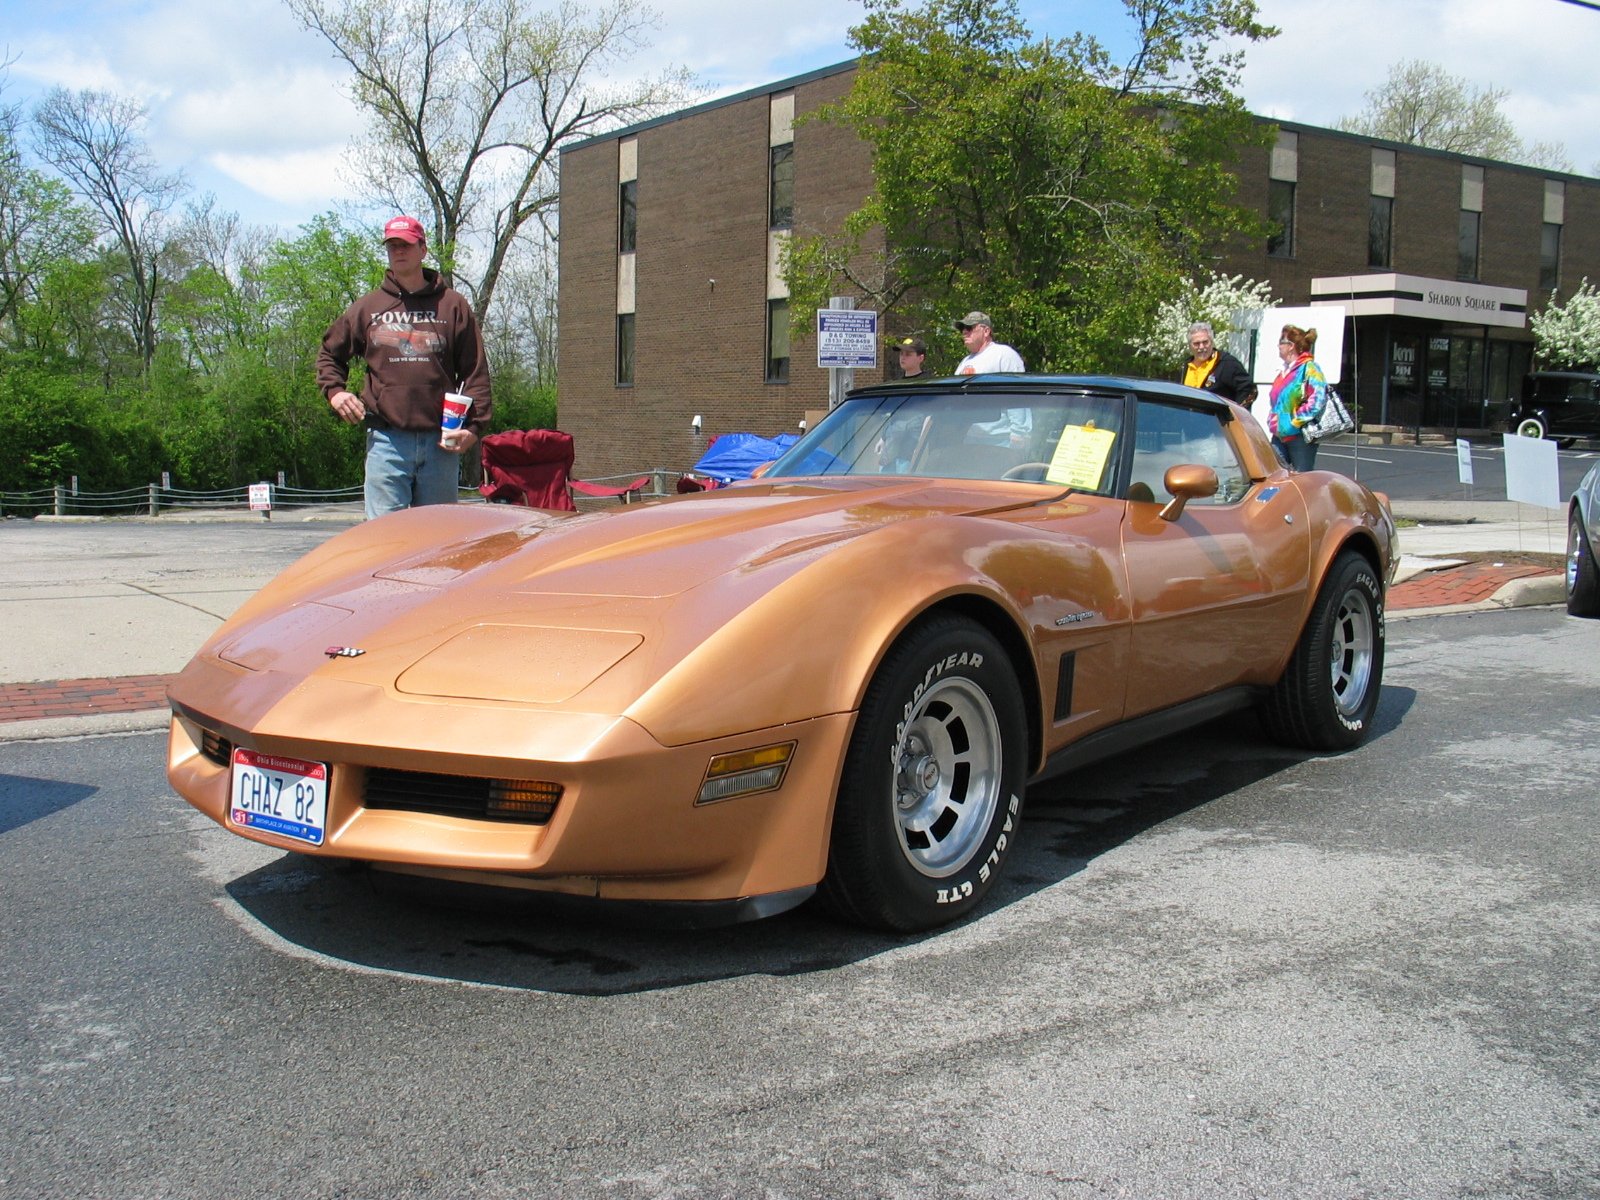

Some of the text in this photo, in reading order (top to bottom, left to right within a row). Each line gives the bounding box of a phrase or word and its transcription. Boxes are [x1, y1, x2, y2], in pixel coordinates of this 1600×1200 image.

[1428, 291, 1497, 311] SHARON SQUARE
[1356, 573, 1378, 599] EAGLE
[256, 755, 305, 771] Ohio Bicentennial
[241, 772, 314, 824] CHAZ 82
[234, 812, 246, 825] 31
[978, 793, 1020, 884] EAGLE
